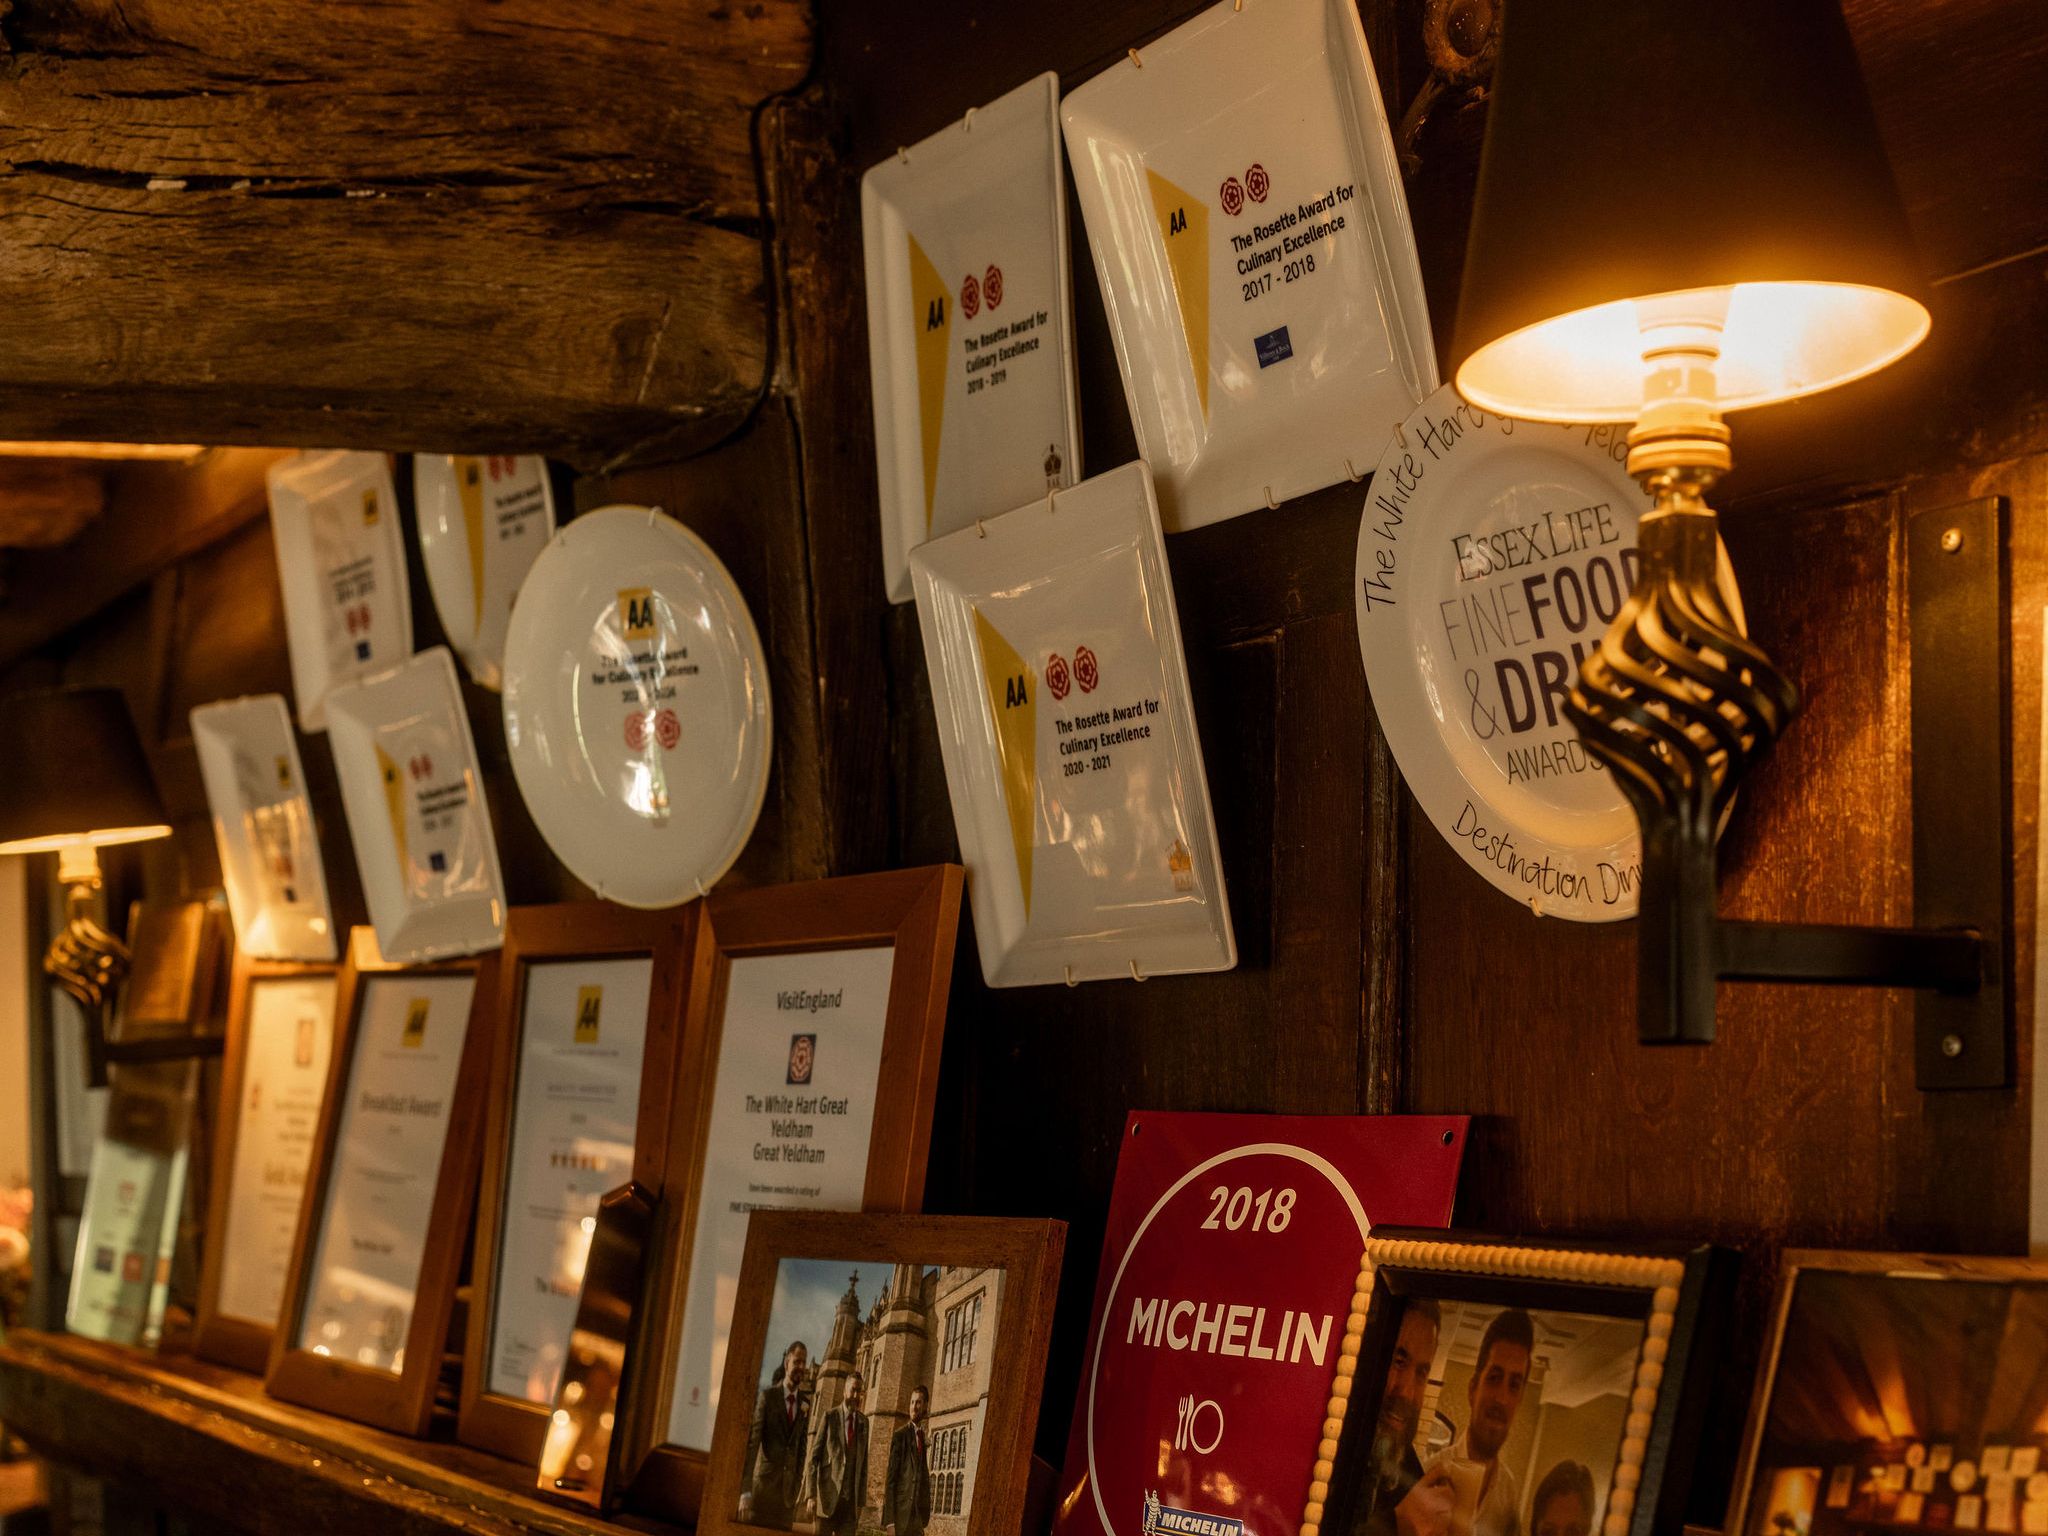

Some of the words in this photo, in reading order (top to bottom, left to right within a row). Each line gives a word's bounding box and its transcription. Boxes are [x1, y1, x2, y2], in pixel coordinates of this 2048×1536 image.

[1170, 208, 1187, 236] AA
[1231, 236, 1253, 253] The
[1253, 212, 1297, 243] Rosette
[1299, 190, 1335, 222] Award
[1336, 184, 1354, 201] for
[1237, 247, 1281, 275] Culinary
[1283, 215, 1345, 254] Excellence
[1242, 273, 1271, 301] 2017
[1284, 254, 1316, 284] 2018
[927, 297, 944, 332] AA
[965, 338, 978, 354] The
[981, 327, 1008, 348] Rosette
[1011, 314, 1034, 335] Award
[1036, 311, 1048, 326] for
[966, 353, 997, 373] Culinary
[999, 337, 1039, 362] Excellence
[991, 369, 1006, 386] 2019
[1416, 402, 1484, 460] Hart
[1373, 453, 1425, 541] White
[1363, 549, 1397, 612] The
[629, 596, 653, 630] AA
[1440, 582, 1531, 661] FINE
[1006, 674, 1028, 709] AA
[1464, 668, 1504, 741] &
[1056, 719, 1073, 735] The
[1075, 711, 1110, 731] Rosette
[1113, 702, 1142, 721] Award
[1144, 698, 1159, 715] for
[1060, 737, 1098, 756] Culinary
[1101, 724, 1150, 747] Excellence
[1063, 762, 1084, 777] 2020
[1092, 755, 1111, 771] 2021
[1507, 738, 1606, 785] AWARD
[1452, 799, 1593, 903] Destination
[777, 987, 843, 1014] VisitEngland
[746, 1094, 762, 1113] The
[765, 1095, 793, 1114] White
[795, 1096, 817, 1114] Hart
[820, 1095, 848, 1115] Great
[771, 1118, 813, 1138] Yeldham
[753, 1142, 780, 1161] Great
[782, 1143, 825, 1163] Yeldham
[1200, 1185, 1297, 1234] 2018
[1126, 1297, 1333, 1366] MICHELIN
[1161, 1512, 1239, 1536] MICHELIN
